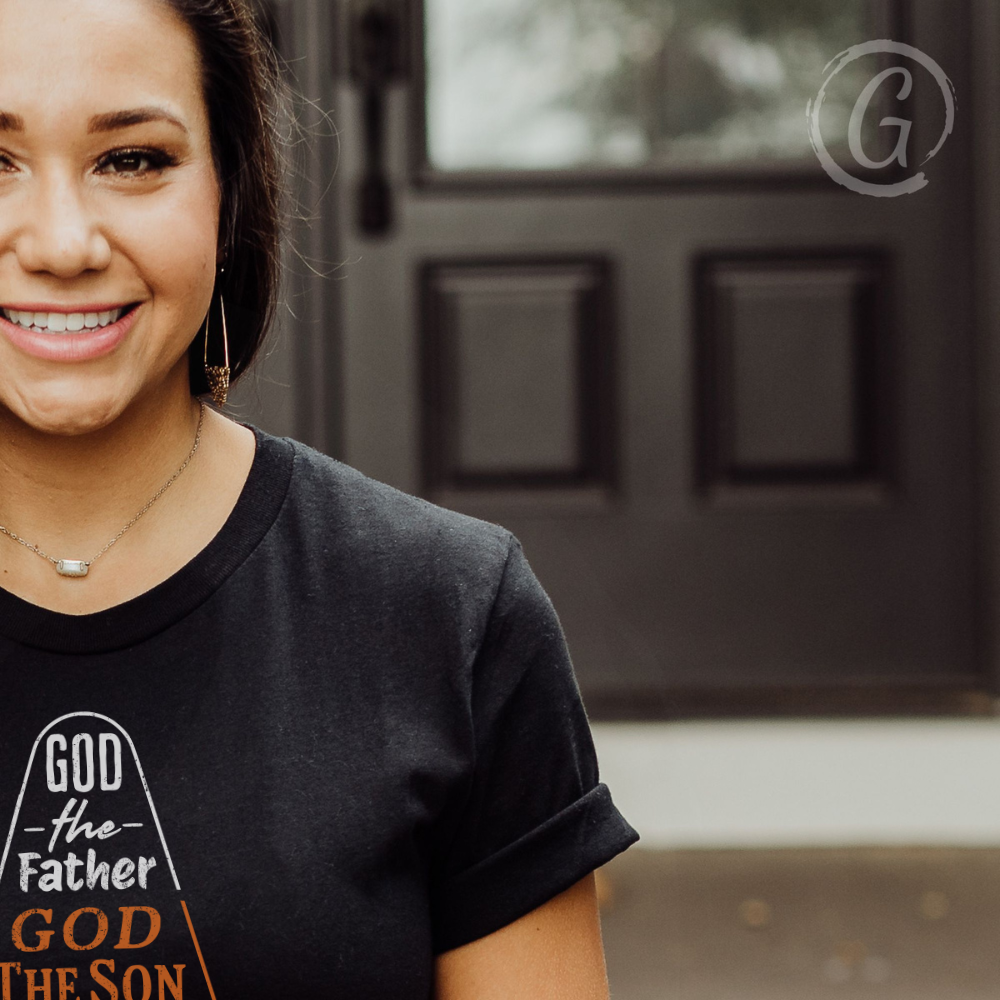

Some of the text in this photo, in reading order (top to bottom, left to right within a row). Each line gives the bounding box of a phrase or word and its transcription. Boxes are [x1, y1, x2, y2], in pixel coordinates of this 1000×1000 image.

[46, 732, 122, 793] GOD
[48, 797, 122, 853] the
[17, 848, 157, 893] Father
[11, 906, 162, 953] GOD
